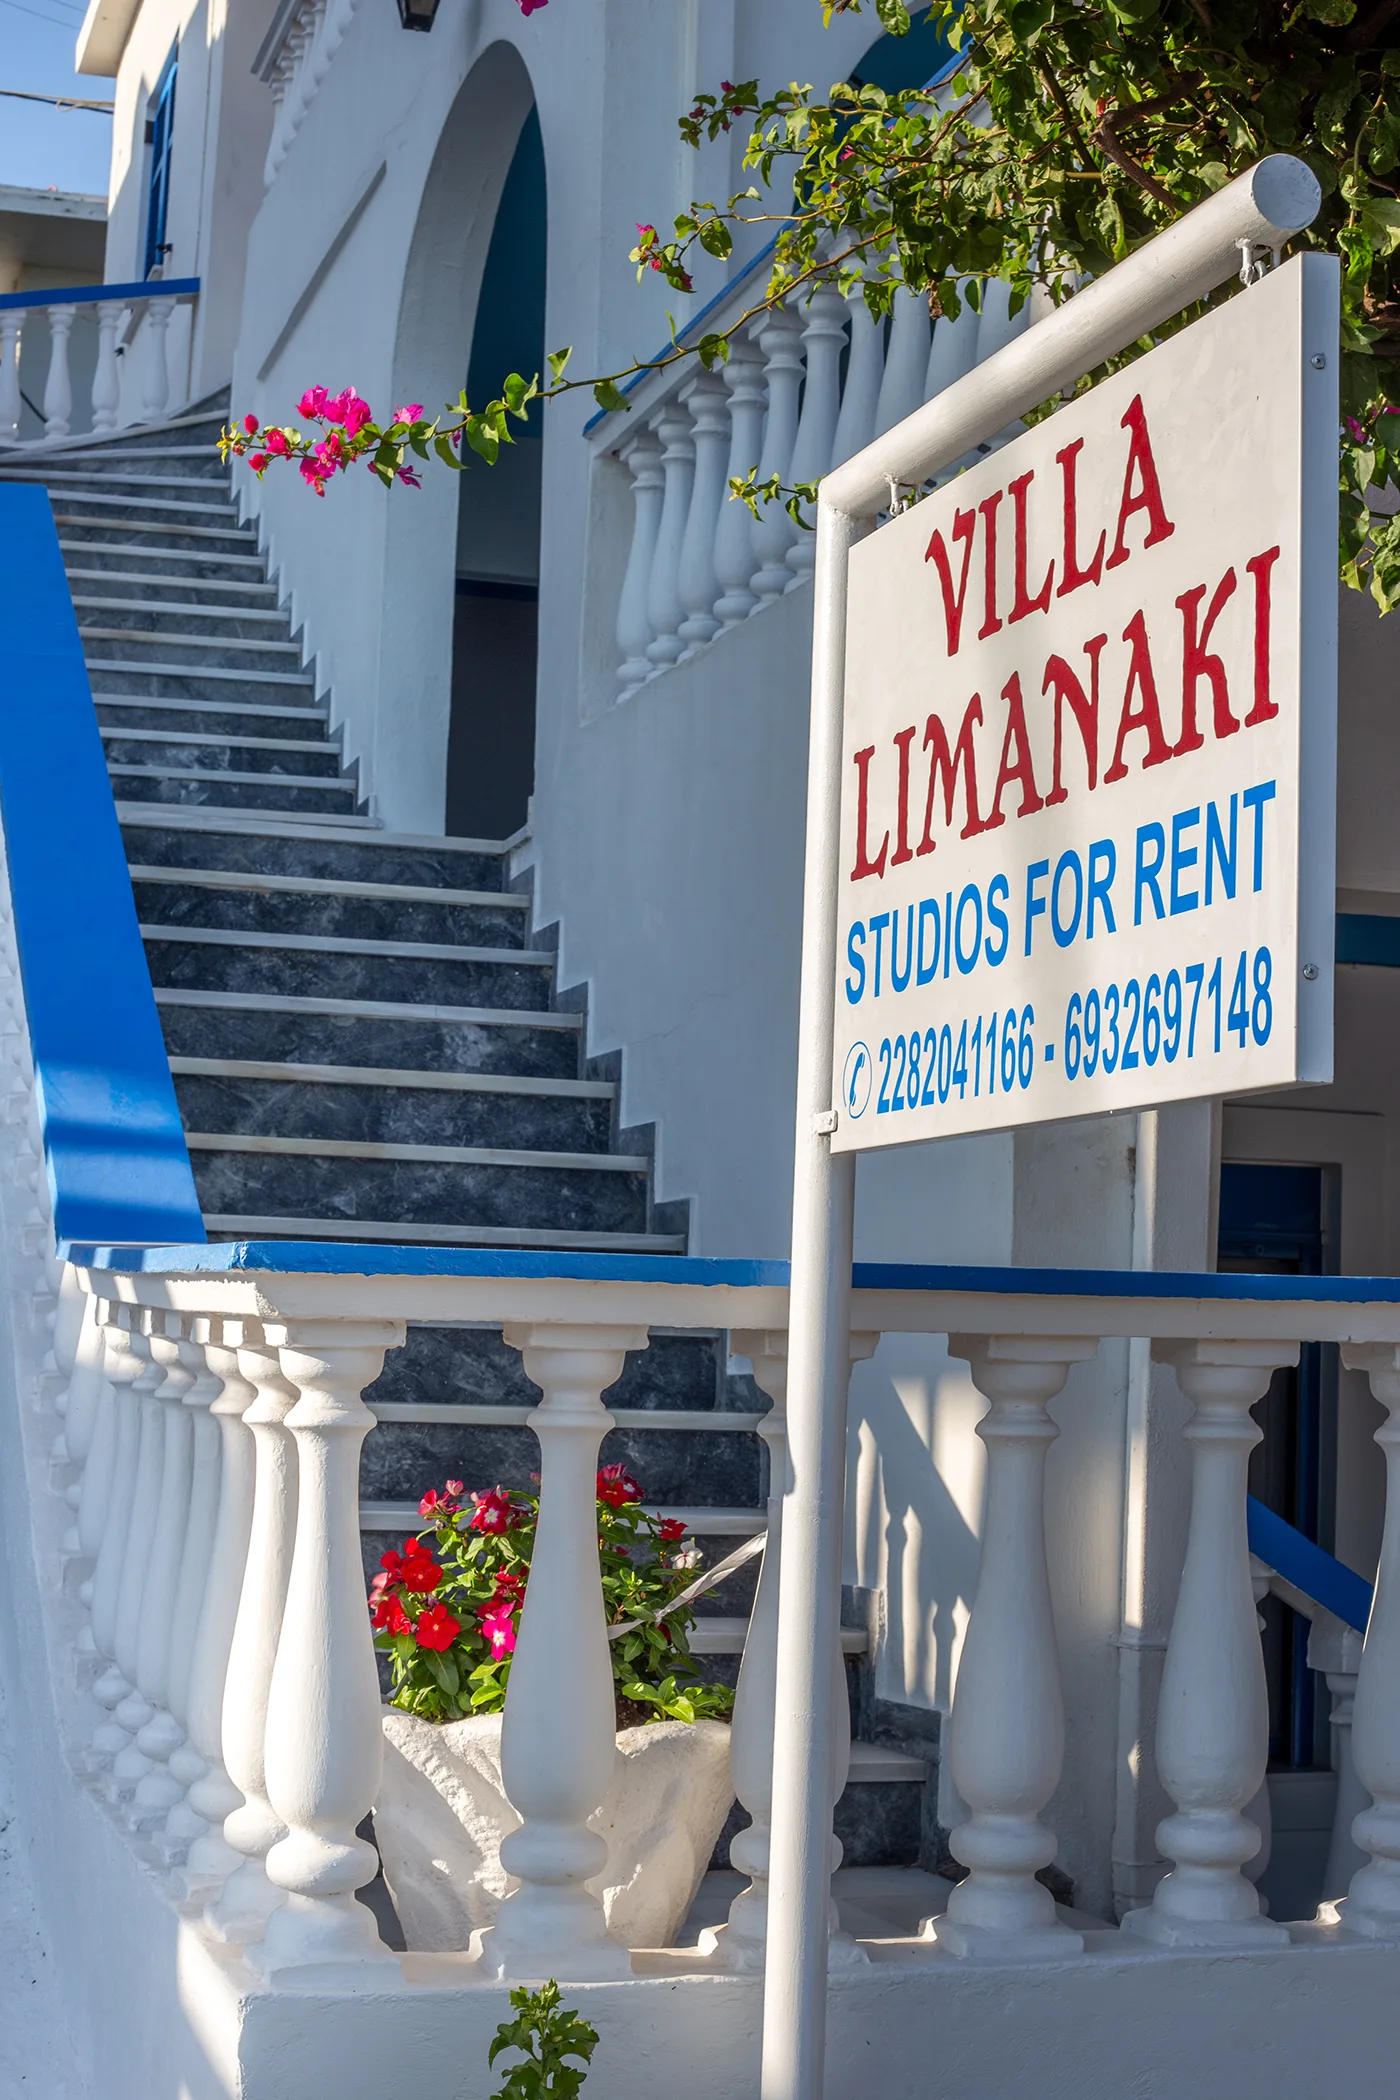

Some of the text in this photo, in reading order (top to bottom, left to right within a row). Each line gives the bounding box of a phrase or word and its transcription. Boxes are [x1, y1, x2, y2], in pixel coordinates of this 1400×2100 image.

[925, 394, 1174, 656] VILLA
[851, 546, 1279, 881] LIMANAKI
[846, 780, 1275, 1004] STUDIOS FOR RENT
[877, 947, 1272, 1113] 2282041166 - 6932697148
